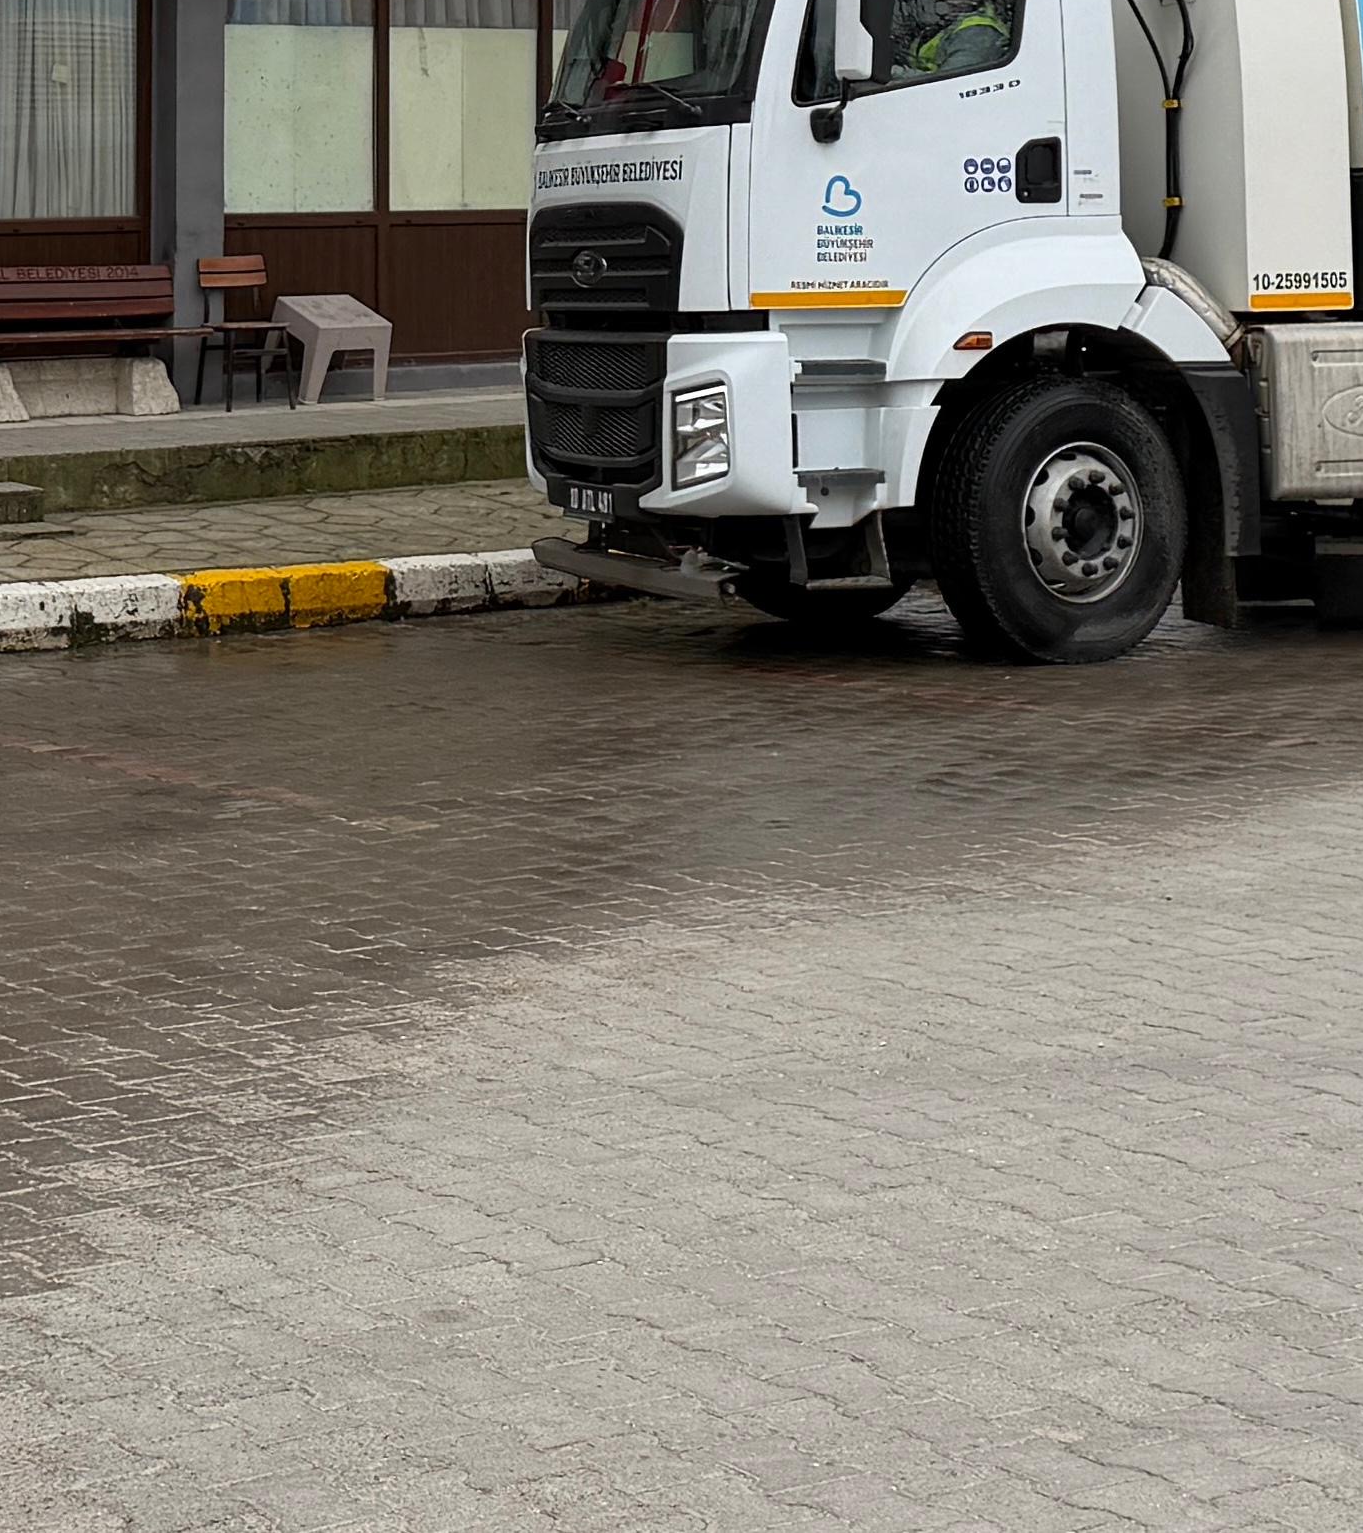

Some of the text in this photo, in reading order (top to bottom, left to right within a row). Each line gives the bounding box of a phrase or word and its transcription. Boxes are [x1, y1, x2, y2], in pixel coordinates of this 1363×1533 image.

[622, 154, 684, 183] BELEDİYESİ
[105, 265, 139, 278] 2014
[1253, 271, 1348, 291] 10-25991505
